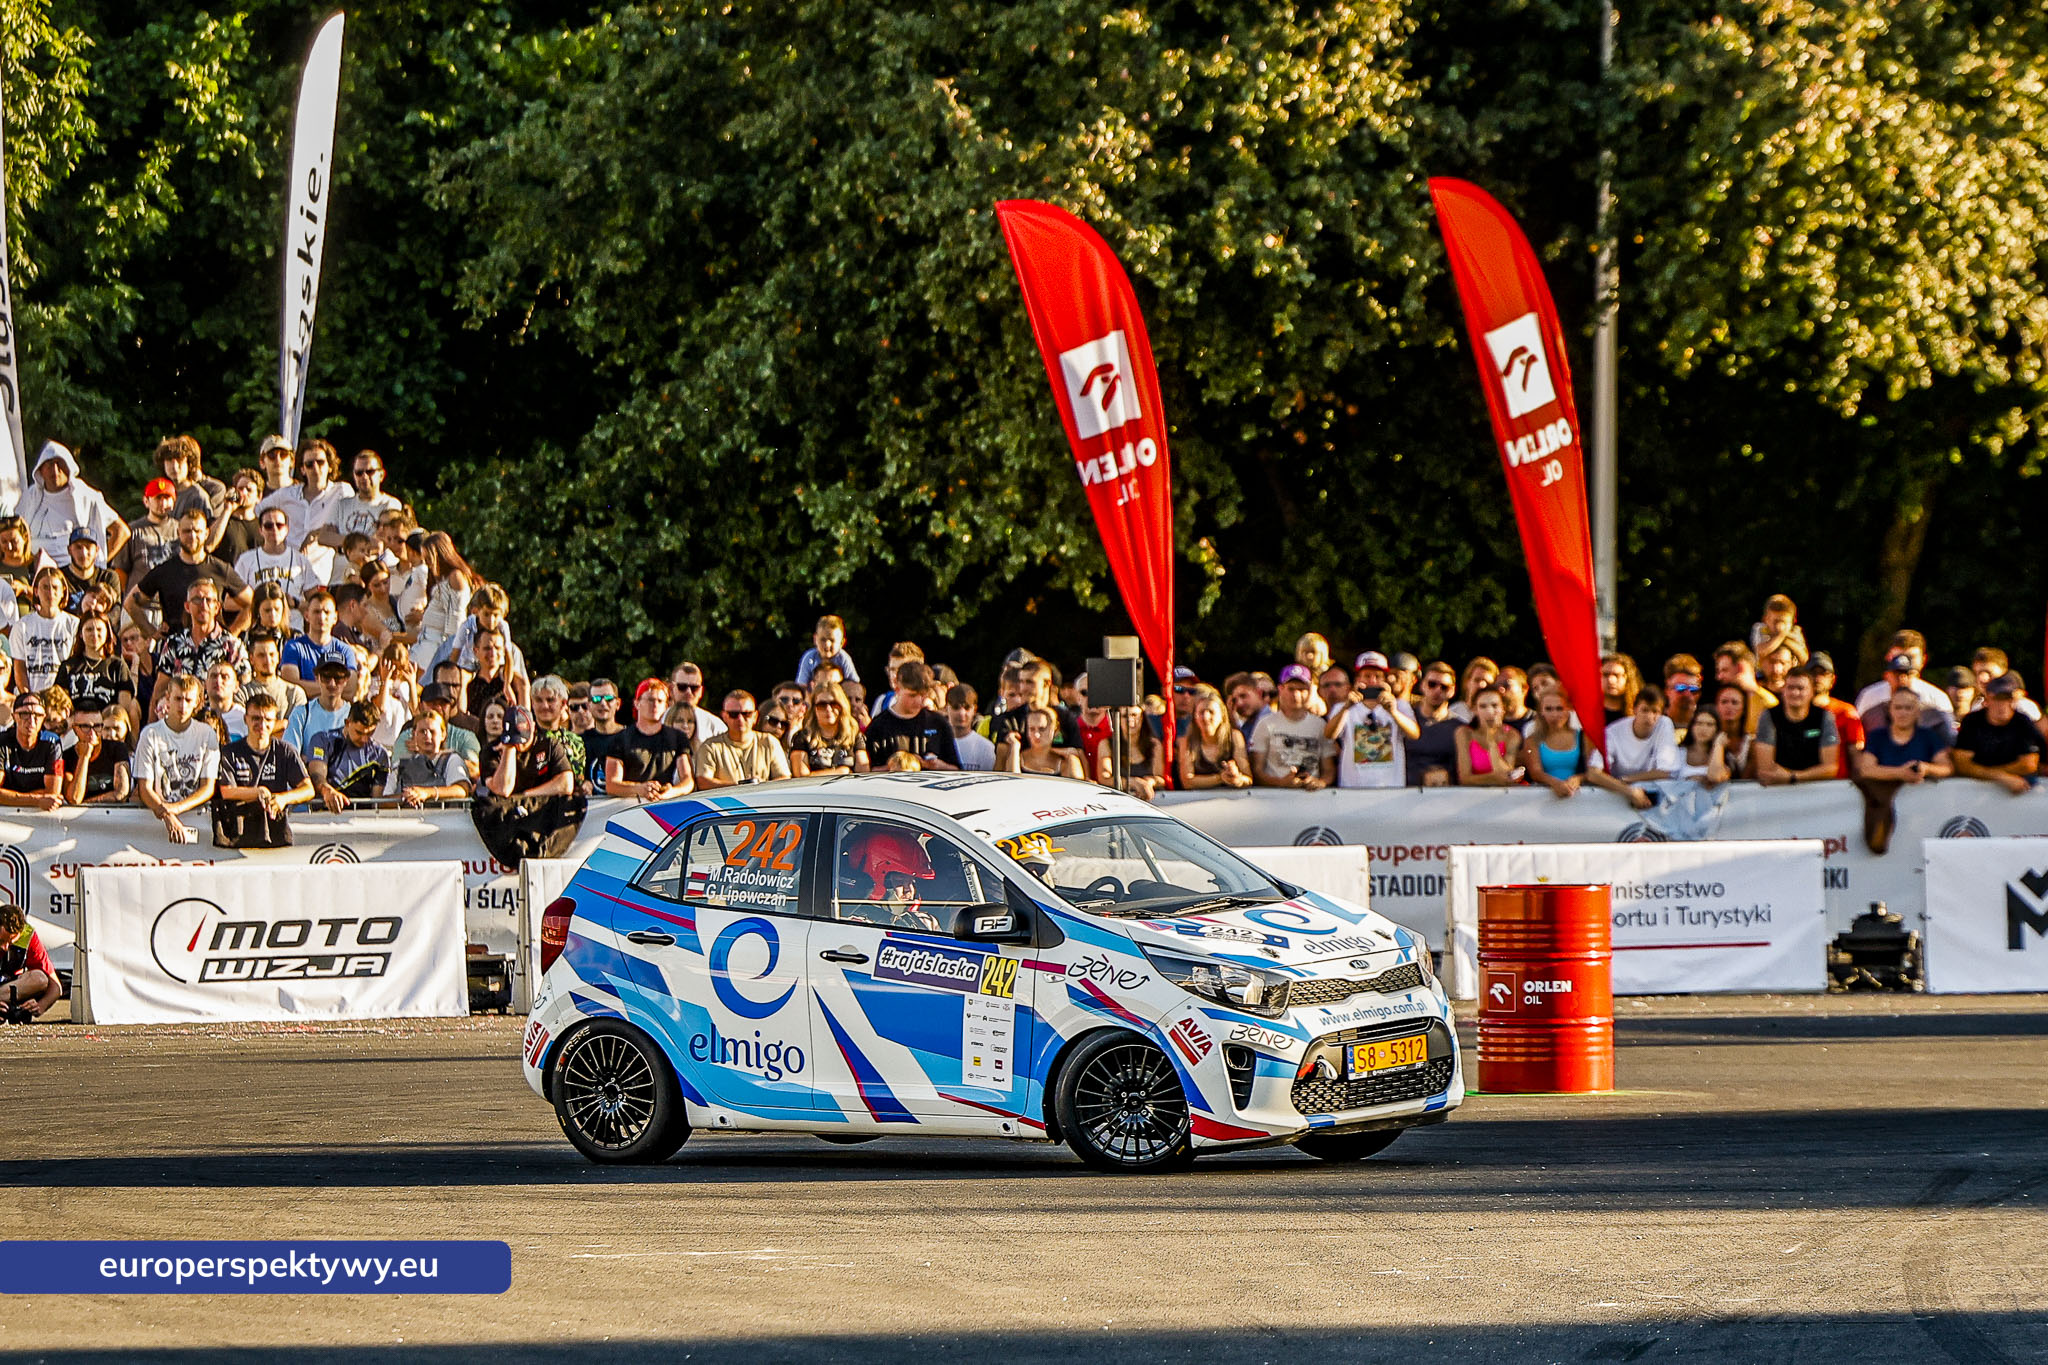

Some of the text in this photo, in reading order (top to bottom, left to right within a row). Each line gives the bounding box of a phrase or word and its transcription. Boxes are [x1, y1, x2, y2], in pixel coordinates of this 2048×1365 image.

[726, 820, 802, 871] 242
[996, 832, 1067, 861] 242
[709, 866, 795, 889] M.Radołowicz
[706, 883, 788, 907] G.Lipowczan
[981, 918, 1009, 930] RF
[1664, 906, 1669, 925] i
[1675, 903, 1772, 929] Turystyki
[209, 916, 403, 951] MOTO
[1211, 926, 1252, 936] 242
[1303, 935, 1376, 955] elmigo
[203, 954, 386, 980] WIZJA
[881, 948, 1018, 999] #rajdslaska 242
[1523, 980, 1572, 993] ORLEN
[1319, 1000, 1428, 1026] www.elmigo.com.pl
[1524, 995, 1542, 1005] OIL
[689, 1022, 805, 1082] elmigo
[1357, 1037, 1424, 1070] S8 5312
